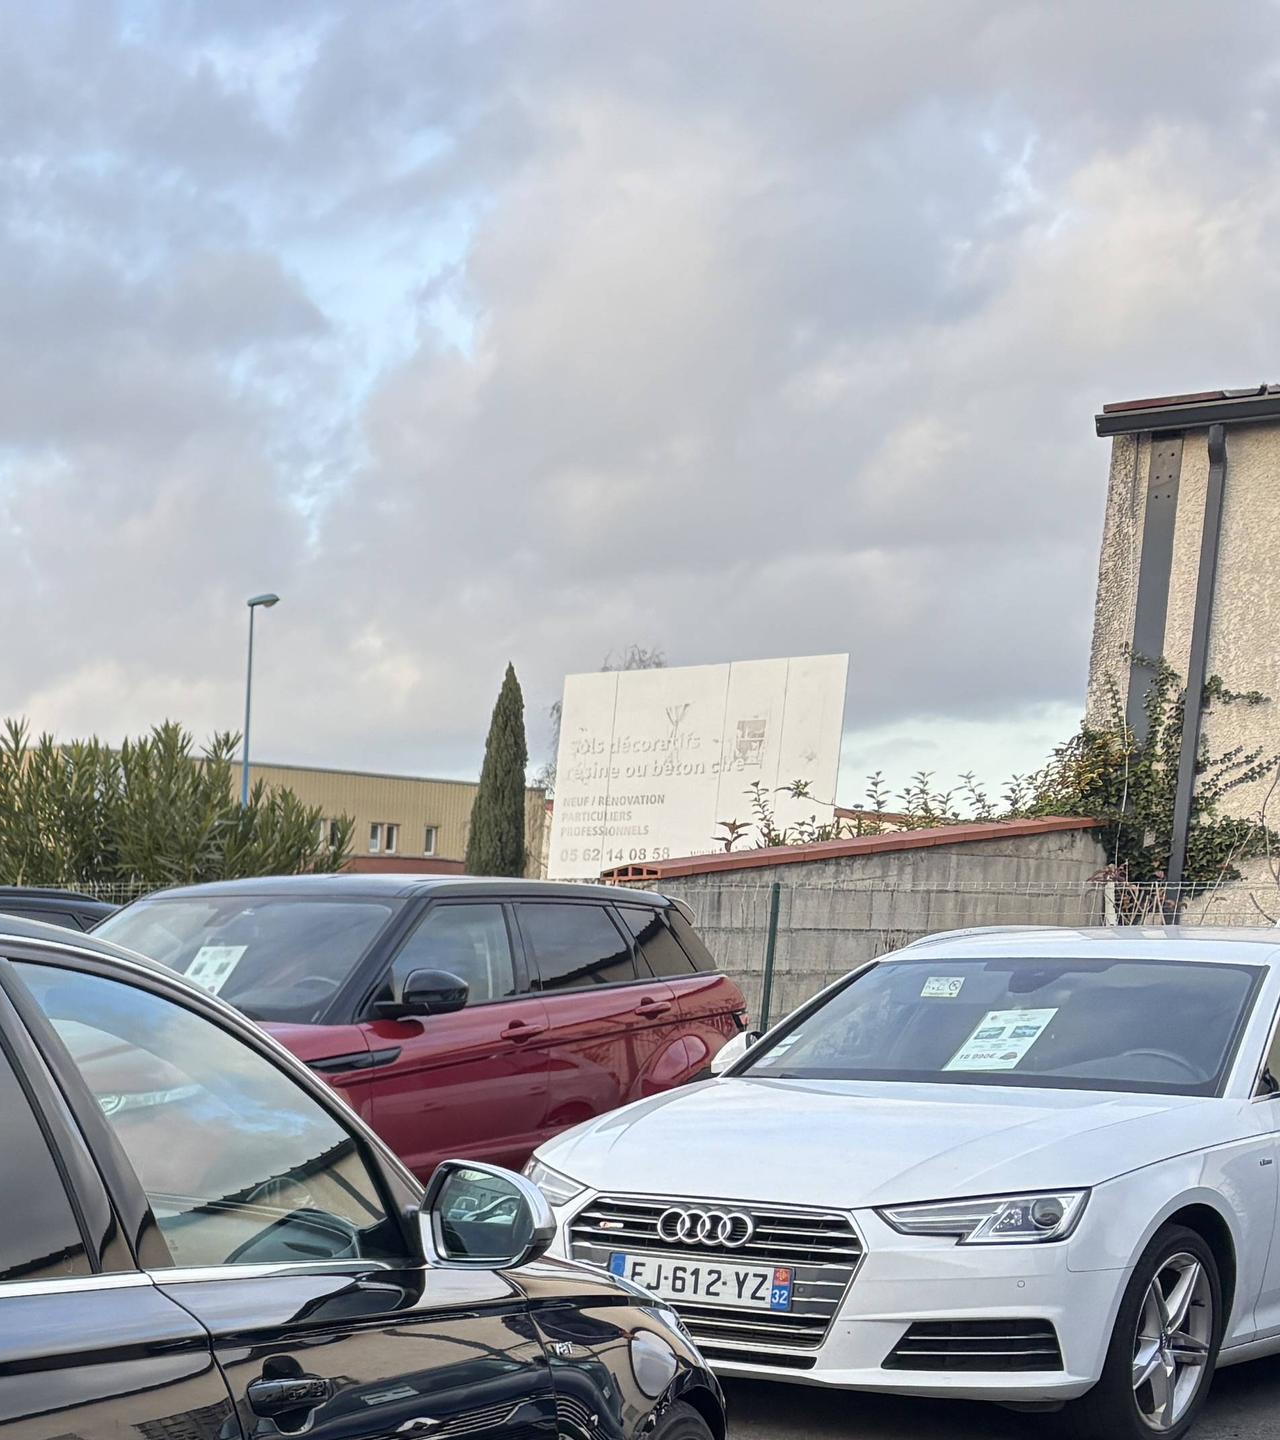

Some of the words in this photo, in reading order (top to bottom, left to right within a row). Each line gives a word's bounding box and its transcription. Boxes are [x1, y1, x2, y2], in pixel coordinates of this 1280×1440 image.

[626, 766, 647, 778] ou
[563, 796, 589, 807] NEUF
[561, 811, 632, 823] PARTICULIERS
[560, 825, 649, 837] PROFESSIONNELS
[560, 849, 578, 862] 05
[582, 848, 601, 861] 62
[606, 848, 624, 862] 14
[629, 847, 646, 861] 08
[652, 847, 670, 860] 58
[771, 1289, 789, 1305] 32
